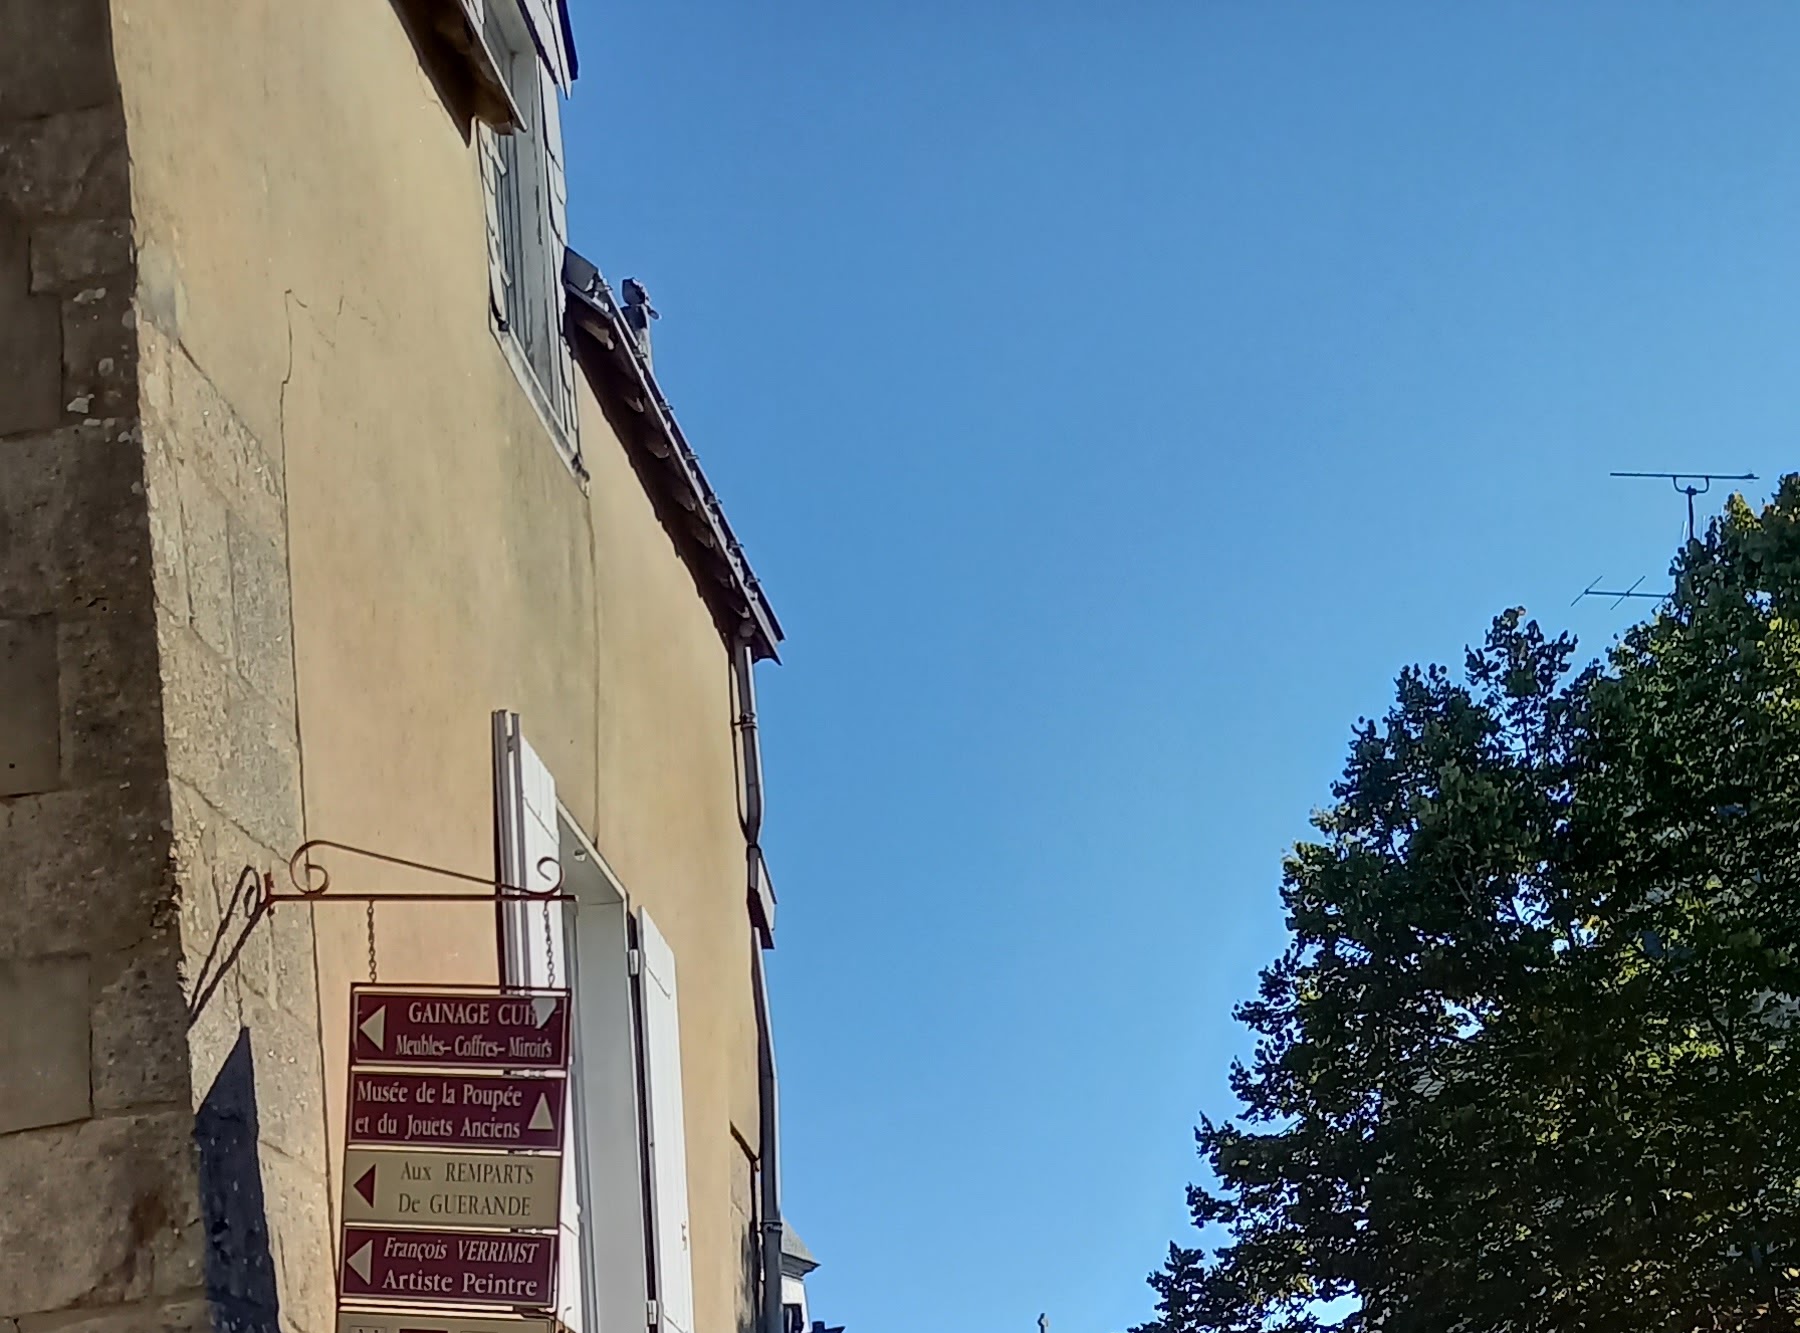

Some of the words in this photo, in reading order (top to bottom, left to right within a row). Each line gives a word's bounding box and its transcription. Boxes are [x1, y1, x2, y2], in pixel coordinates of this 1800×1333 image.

[409, 1002, 490, 1025] GAINAGE
[508, 1036, 552, 1058] Miroirs
[357, 1080, 408, 1102] Musée
[416, 1081, 435, 1103] de
[442, 1082, 455, 1104] la
[463, 1084, 522, 1112] Poupée
[355, 1116, 369, 1133] et
[377, 1113, 397, 1134] du
[405, 1114, 453, 1139] Jouets
[460, 1117, 520, 1138] Anciens
[400, 1161, 432, 1180] Aux
[445, 1162, 534, 1184] REMPARTS
[399, 1193, 421, 1213] De
[429, 1194, 531, 1216] GUERANDE
[383, 1237, 447, 1262] François
[457, 1240, 539, 1264] VERRIMST
[382, 1269, 453, 1292] Artiste
[462, 1272, 537, 1296] Peintre
